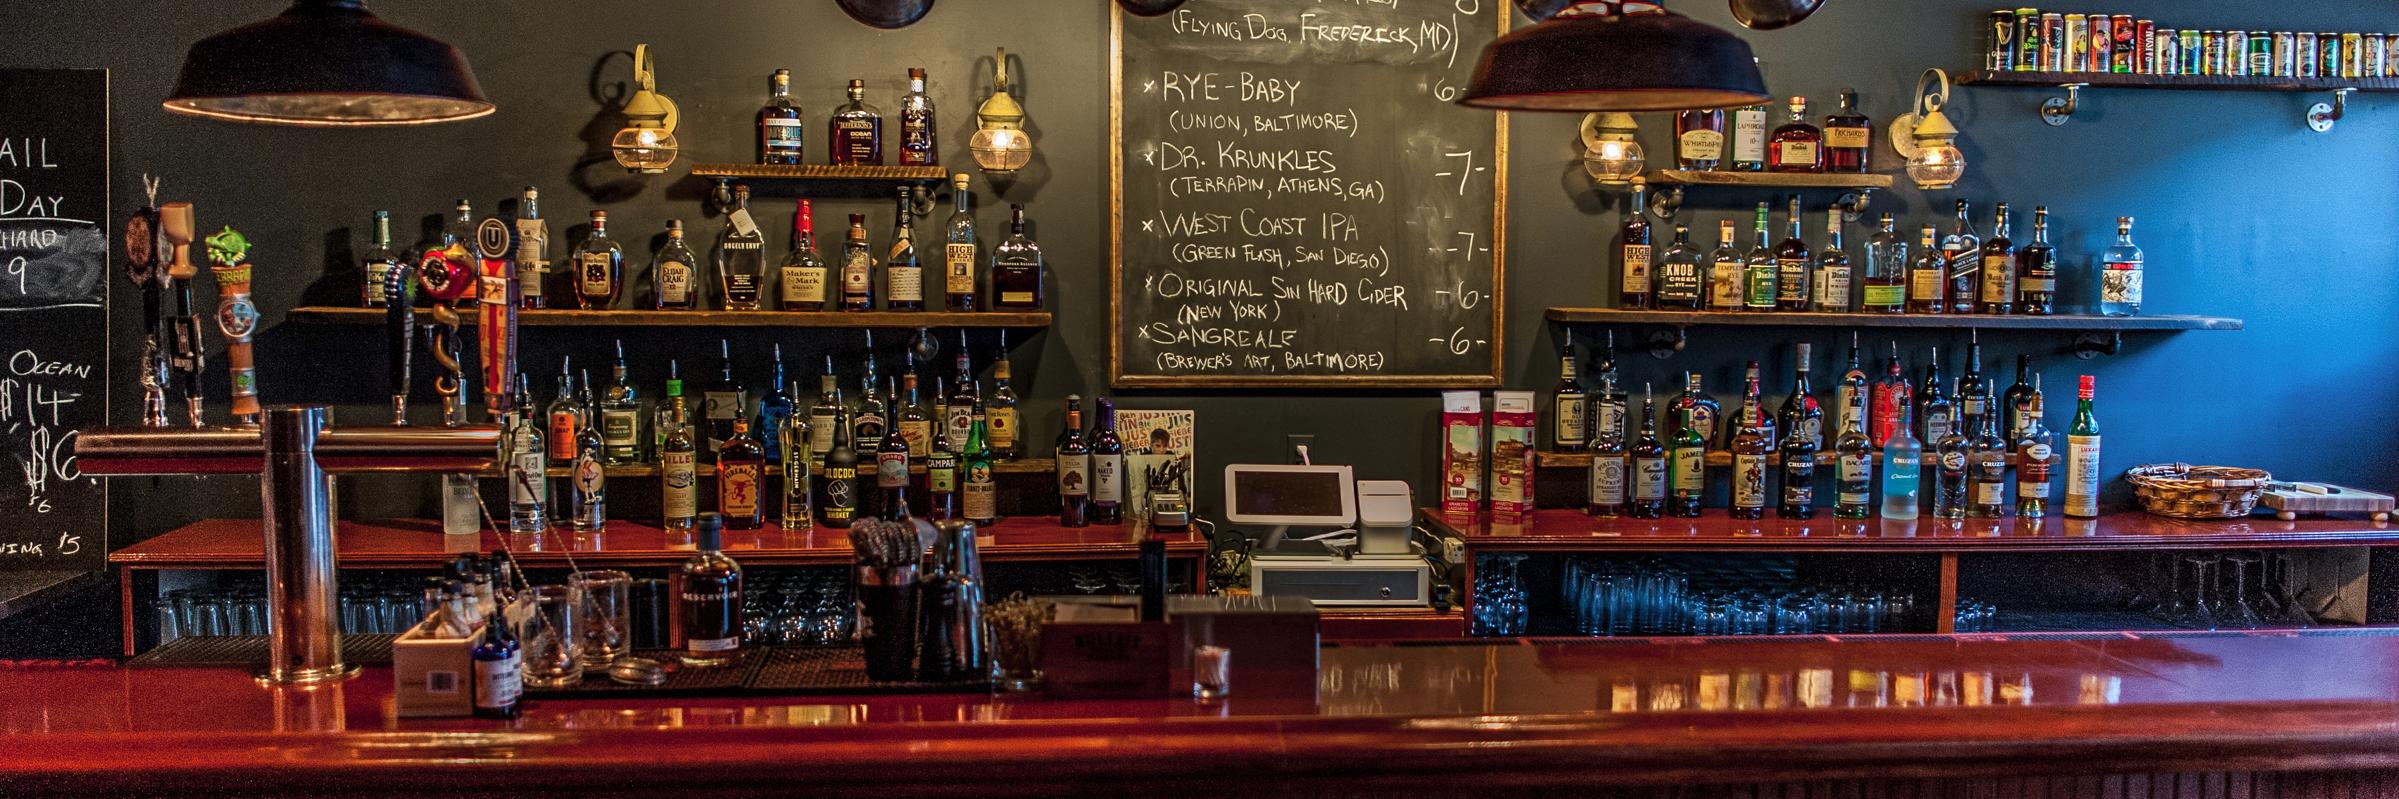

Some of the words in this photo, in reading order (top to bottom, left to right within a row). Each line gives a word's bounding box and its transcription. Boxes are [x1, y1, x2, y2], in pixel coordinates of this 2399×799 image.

[1171, 9, 1242, 39] (FLYING
[1300, 13, 1418, 54] FREDERICK,
[1169, 110, 1248, 137] (UNION,
[1254, 108, 1359, 138] BALTIMORE)
[1161, 142, 1206, 172] DR.
[1218, 141, 1337, 173] KRUNKLES
[1170, 176, 1272, 200] (TERRAPIN,
[1277, 176, 1347, 200] ATHENS,
[1348, 179, 1385, 204] GA)
[1159, 209, 1232, 238] WEST
[1240, 208, 1307, 236] COAST
[1322, 212, 1359, 242] IPA
[948, 245, 973, 254] HIGH
[1172, 243, 1236, 264] (GREEN
[1244, 244, 1291, 270] FLASH,
[1295, 245, 1324, 263] SAN
[1334, 244, 1390, 277] DIEGO)
[1626, 246, 1650, 255] HIGH
[8, 256, 29, 295] 9
[662, 275, 684, 284] CRAIG
[1666, 263, 1694, 276] KNOB
[1158, 272, 1263, 298] ORIGINAL
[1271, 276, 1300, 300] SIN
[1308, 279, 1348, 306] HARD
[1357, 278, 1408, 311] CIDER
[1177, 302, 1222, 325] (NEW
[1151, 322, 1297, 348] SANGREALE
[10, 349, 91, 379] OCEAN
[1244, 352, 1276, 372] ART,
[1285, 350, 1384, 371] BALTIMORE)
[960, 407, 972, 417] BEA
